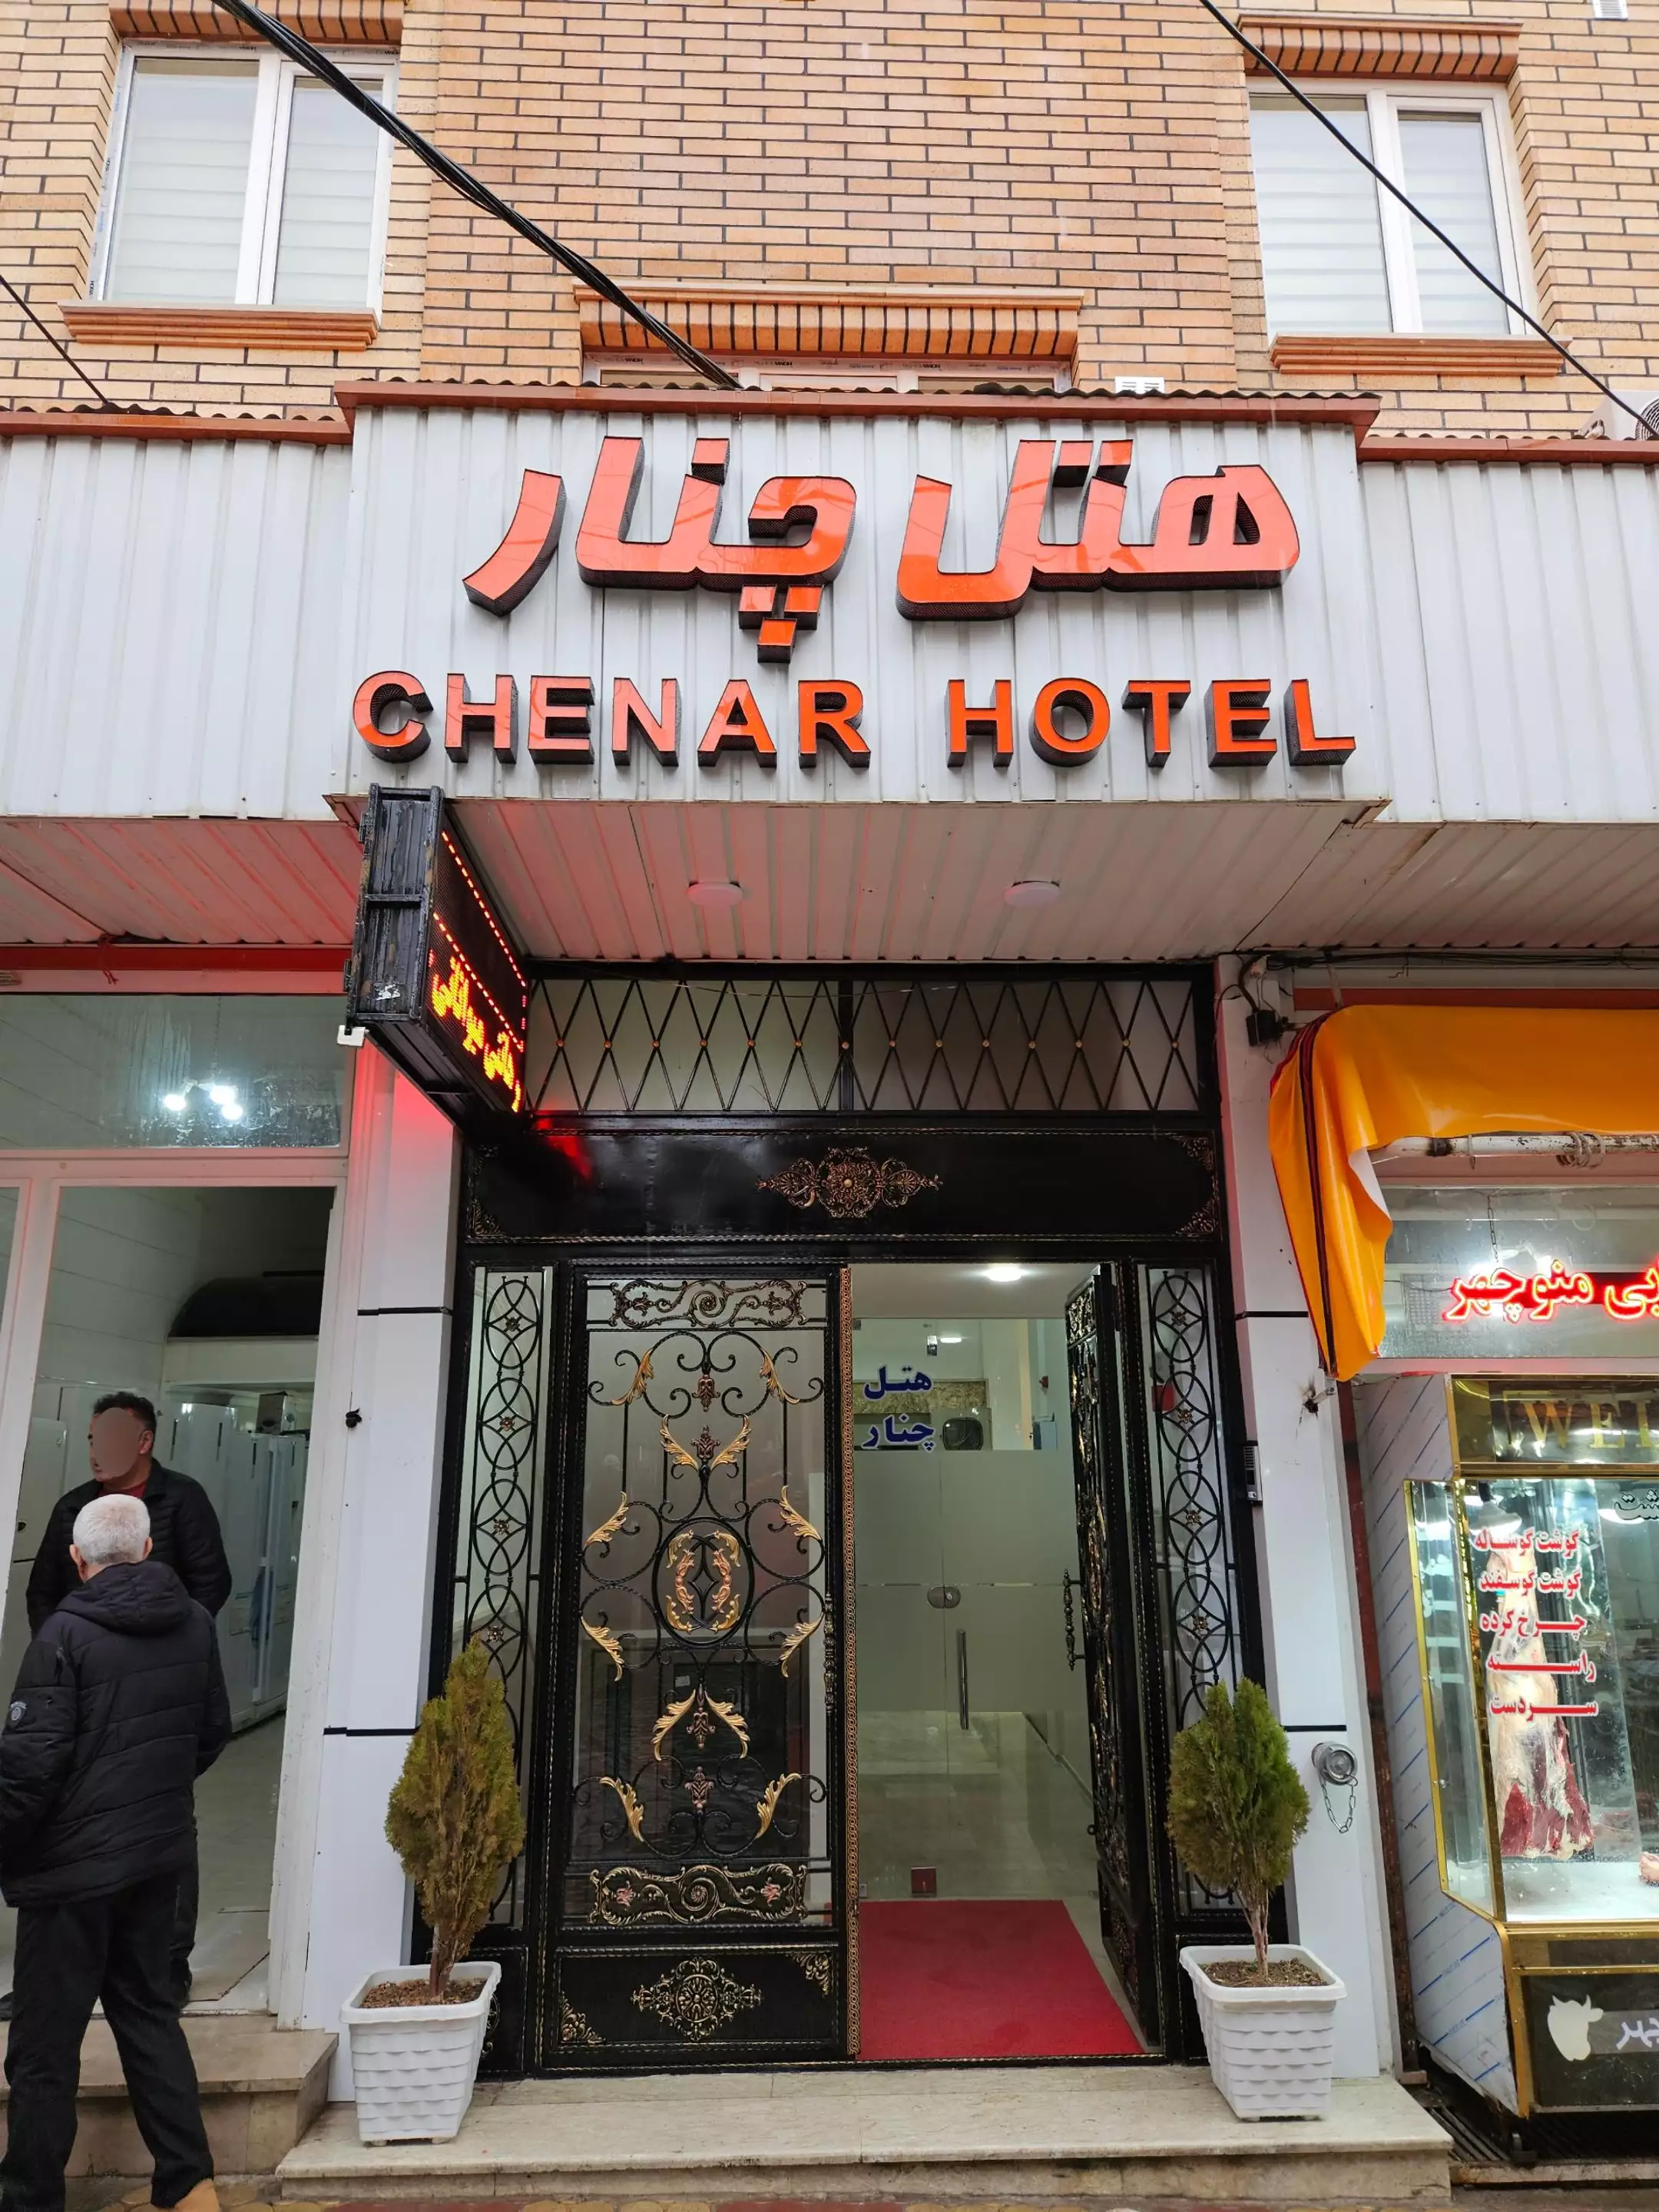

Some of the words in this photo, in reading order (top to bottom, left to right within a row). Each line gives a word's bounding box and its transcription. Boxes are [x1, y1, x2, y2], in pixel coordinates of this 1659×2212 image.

[896, 439, 1301, 619] هتل
[462, 436, 857, 663] چنار
[353, 671, 870, 767] CHENAR
[947, 677, 1356, 767] HOTEL
[864, 1365, 932, 1399] هتل
[862, 1413, 935, 1451] چنار
[1475, 1528, 1534, 1556] گوساله
[1537, 1529, 1579, 1558] گوشت
[1481, 1569, 1535, 1596] گوسفند
[1539, 1568, 1581, 1598] گوشت
[1482, 1609, 1516, 1637] کرده
[1516, 1610, 1585, 1641] چرخ
[1488, 1652, 1595, 1681] راسته
[1489, 1695, 1598, 1722] سردست
